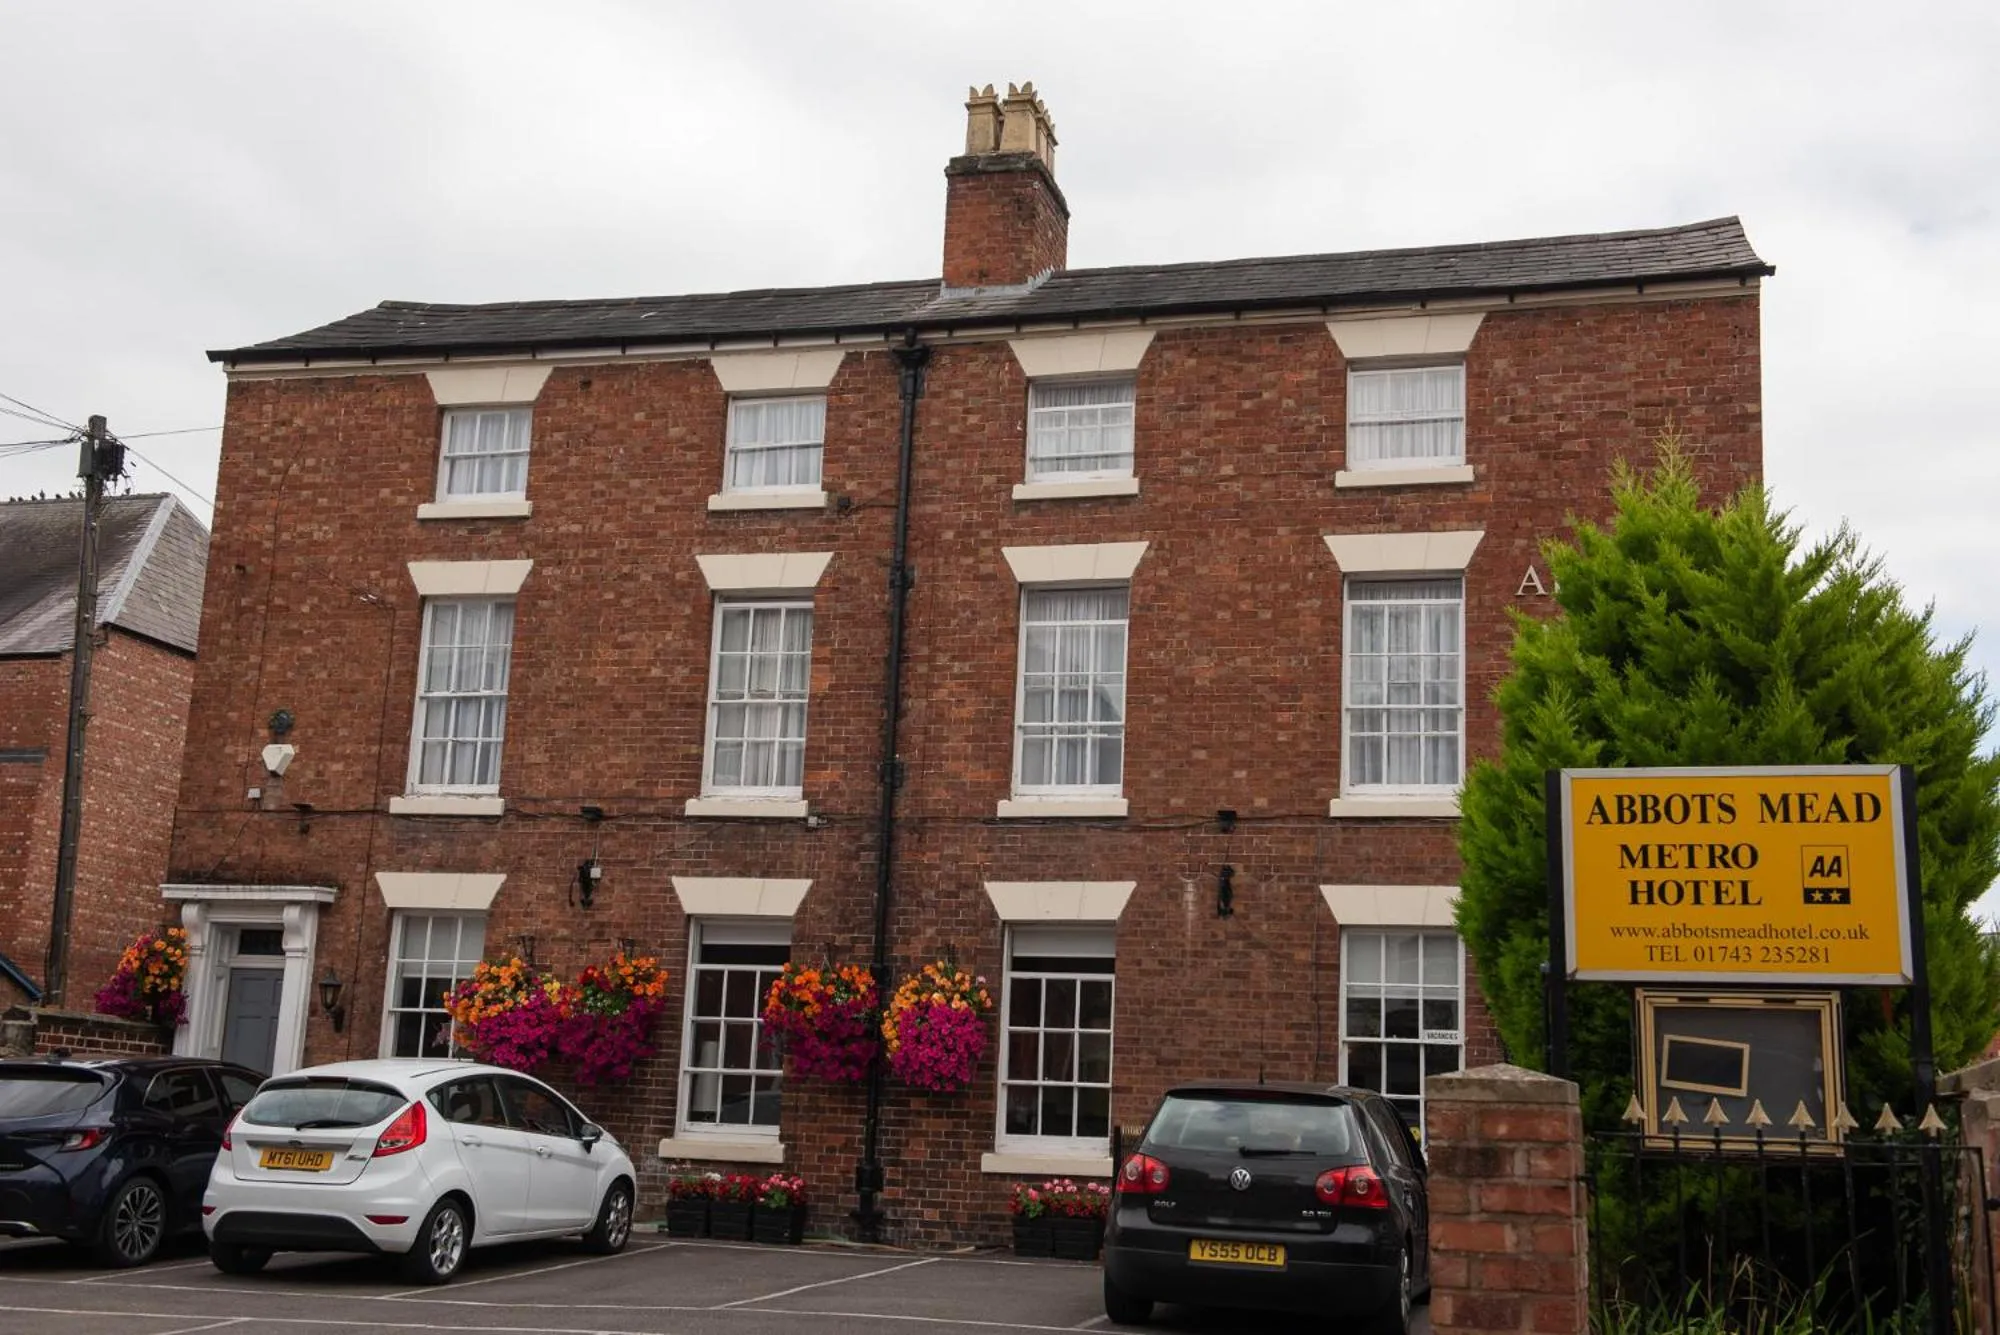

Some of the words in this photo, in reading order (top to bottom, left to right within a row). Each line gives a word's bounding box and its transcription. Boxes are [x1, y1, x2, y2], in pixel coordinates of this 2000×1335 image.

[1514, 564, 1560, 596] A
[1586, 793, 1737, 825] ABBOTS
[1759, 792, 1882, 824] MEAD
[1617, 843, 1759, 869] METRO
[1808, 855, 1842, 878] AA
[1628, 880, 1762, 905] HOTEL
[1610, 923, 1869, 940] www.abbotsmeadhotel.co.uk
[1645, 945, 1688, 962] TEL
[1693, 945, 1752, 963] 01743
[1760, 946, 1831, 963] 235281
[1199, 1241, 1240, 1259] YS55
